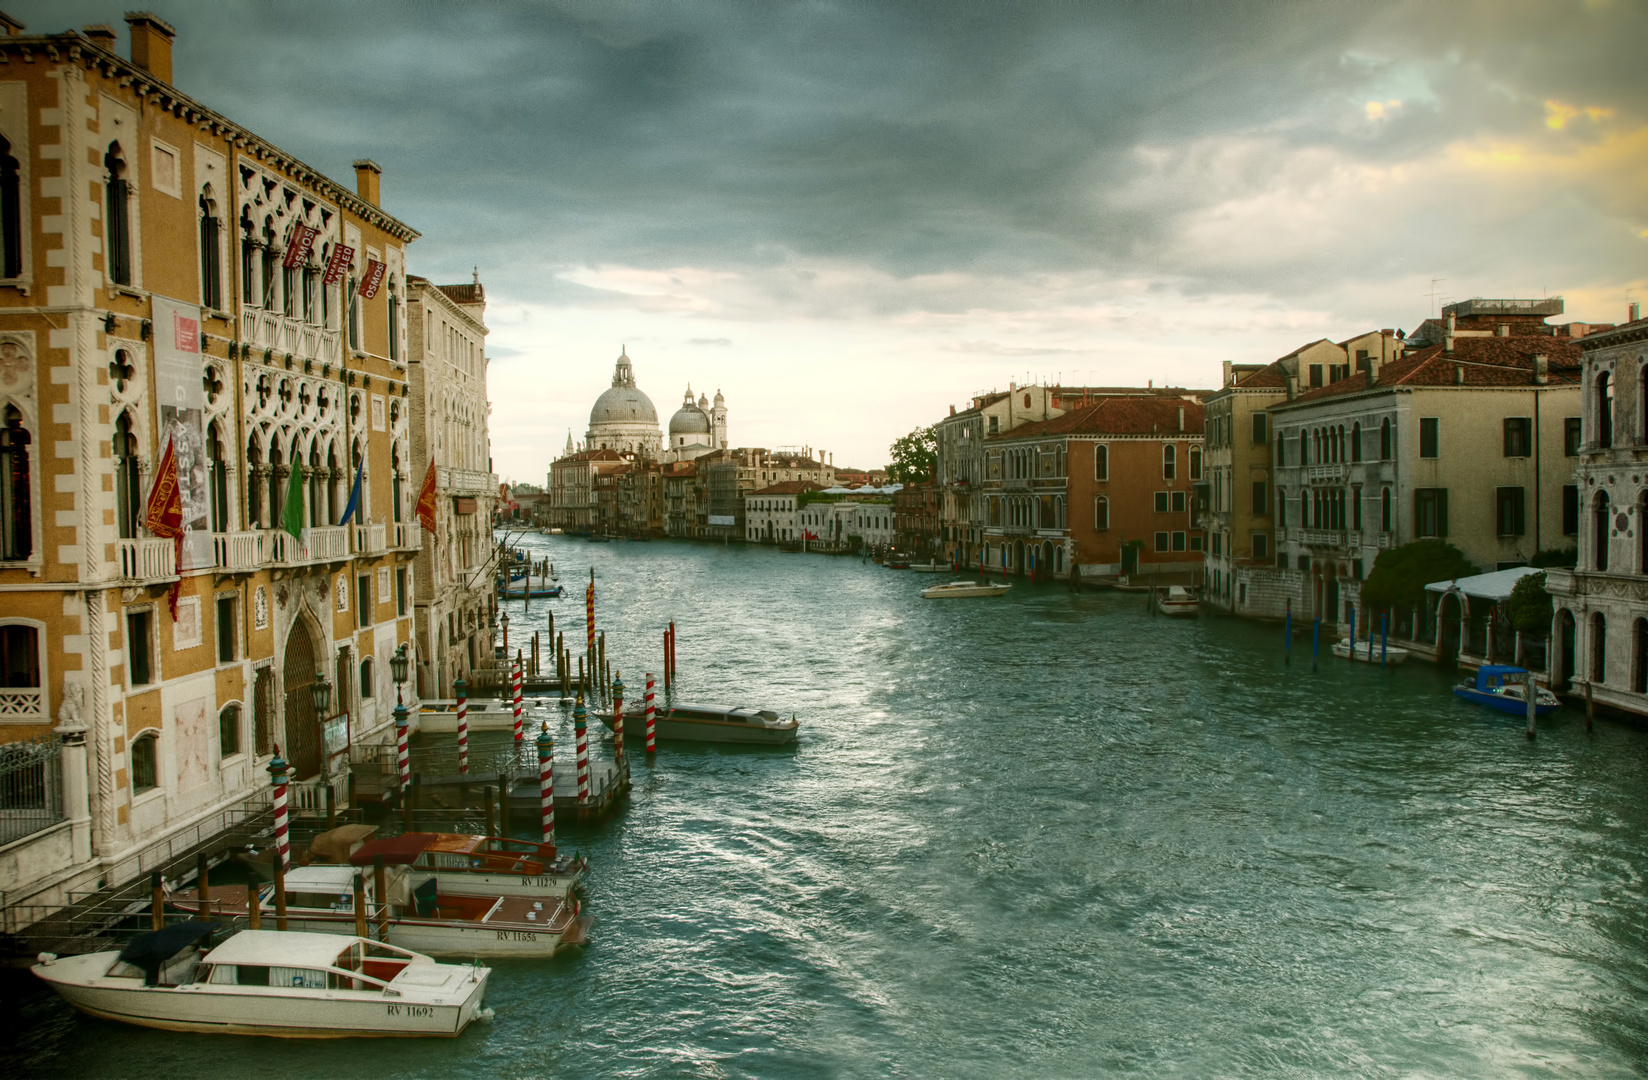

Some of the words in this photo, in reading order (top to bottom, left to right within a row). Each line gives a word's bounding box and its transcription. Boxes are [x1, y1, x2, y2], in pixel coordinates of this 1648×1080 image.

[365, 263, 385, 298] OSMOSI
[175, 385, 194, 551] GLASSTRESS
[522, 877, 534, 887] RV
[497, 931, 510, 940] RV
[387, 1005, 402, 1016] RV
[407, 1006, 434, 1018] 11692
